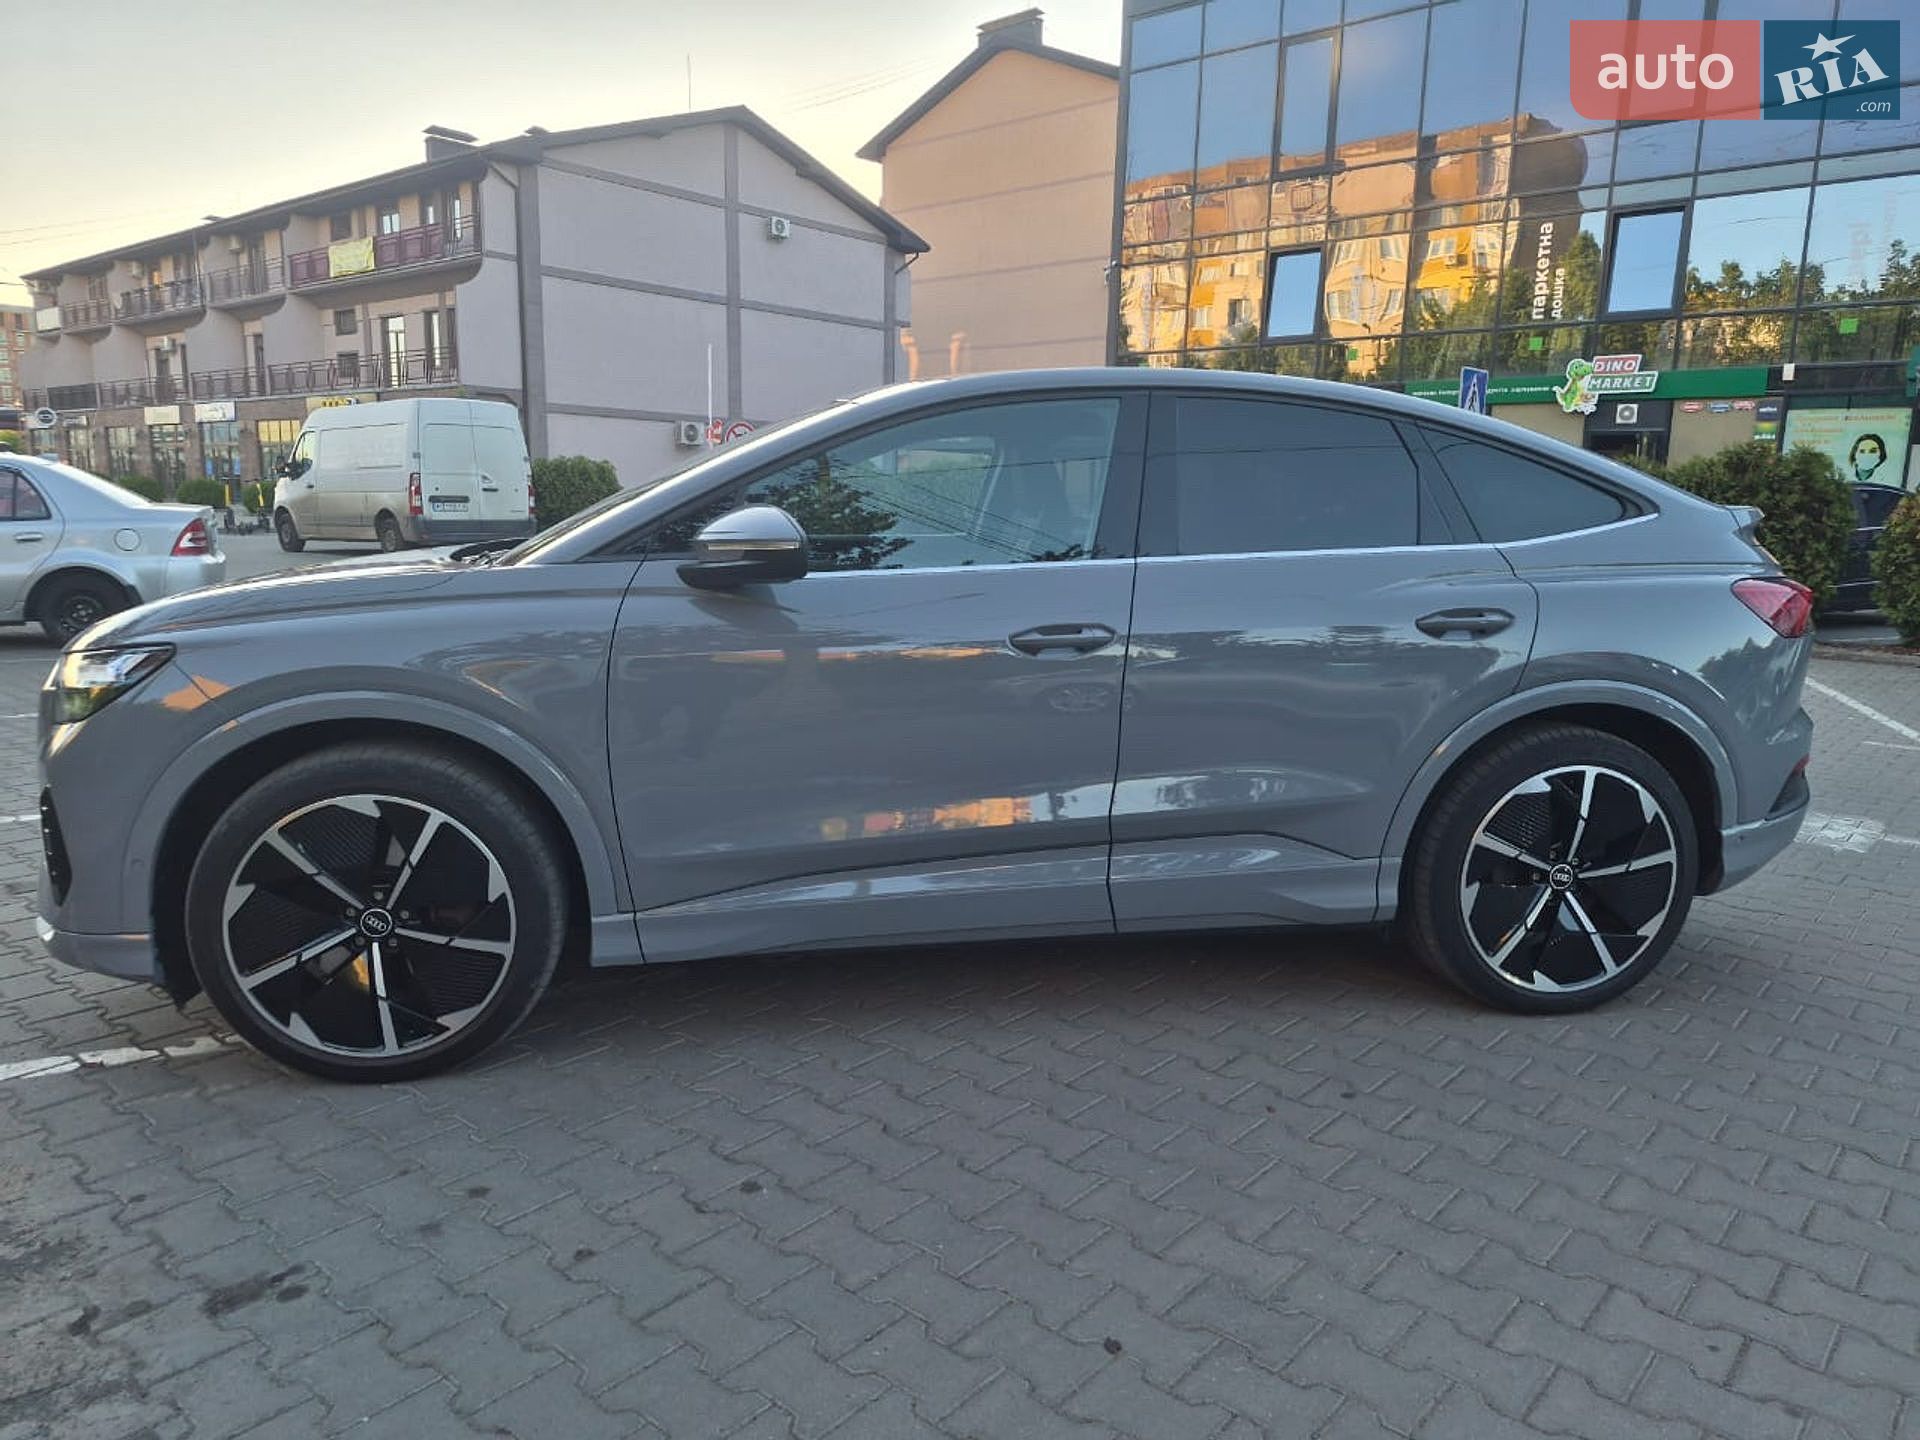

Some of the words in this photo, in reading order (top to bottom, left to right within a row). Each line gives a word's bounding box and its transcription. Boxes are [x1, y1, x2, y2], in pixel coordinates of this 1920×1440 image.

[1532, 222, 1554, 320] паркетна
[1551, 267, 1565, 318] дошка
[1594, 359, 1636, 372] DINO
[1588, 376, 1653, 390] MARKET
